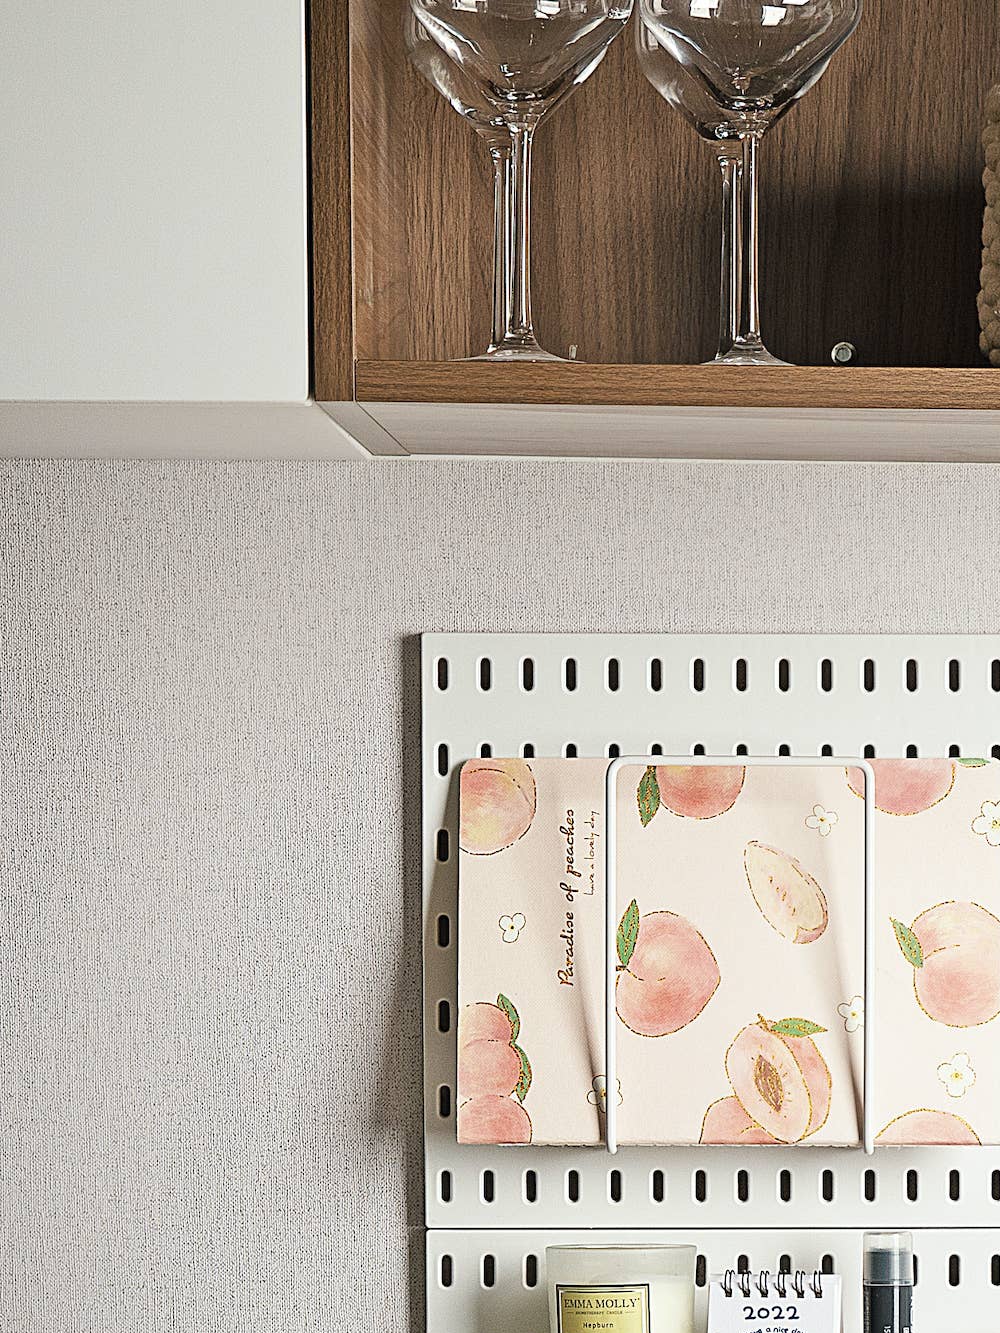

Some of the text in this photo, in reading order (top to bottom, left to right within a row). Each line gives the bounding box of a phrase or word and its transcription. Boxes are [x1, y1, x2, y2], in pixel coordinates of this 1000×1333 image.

[584, 811, 600, 829] day
[557, 809, 581, 987] Paradise of peaches
[564, 1299, 593, 1309] EMMA
[742, 1306, 800, 1320] 2022
[583, 1322, 614, 1330] Hepburn
